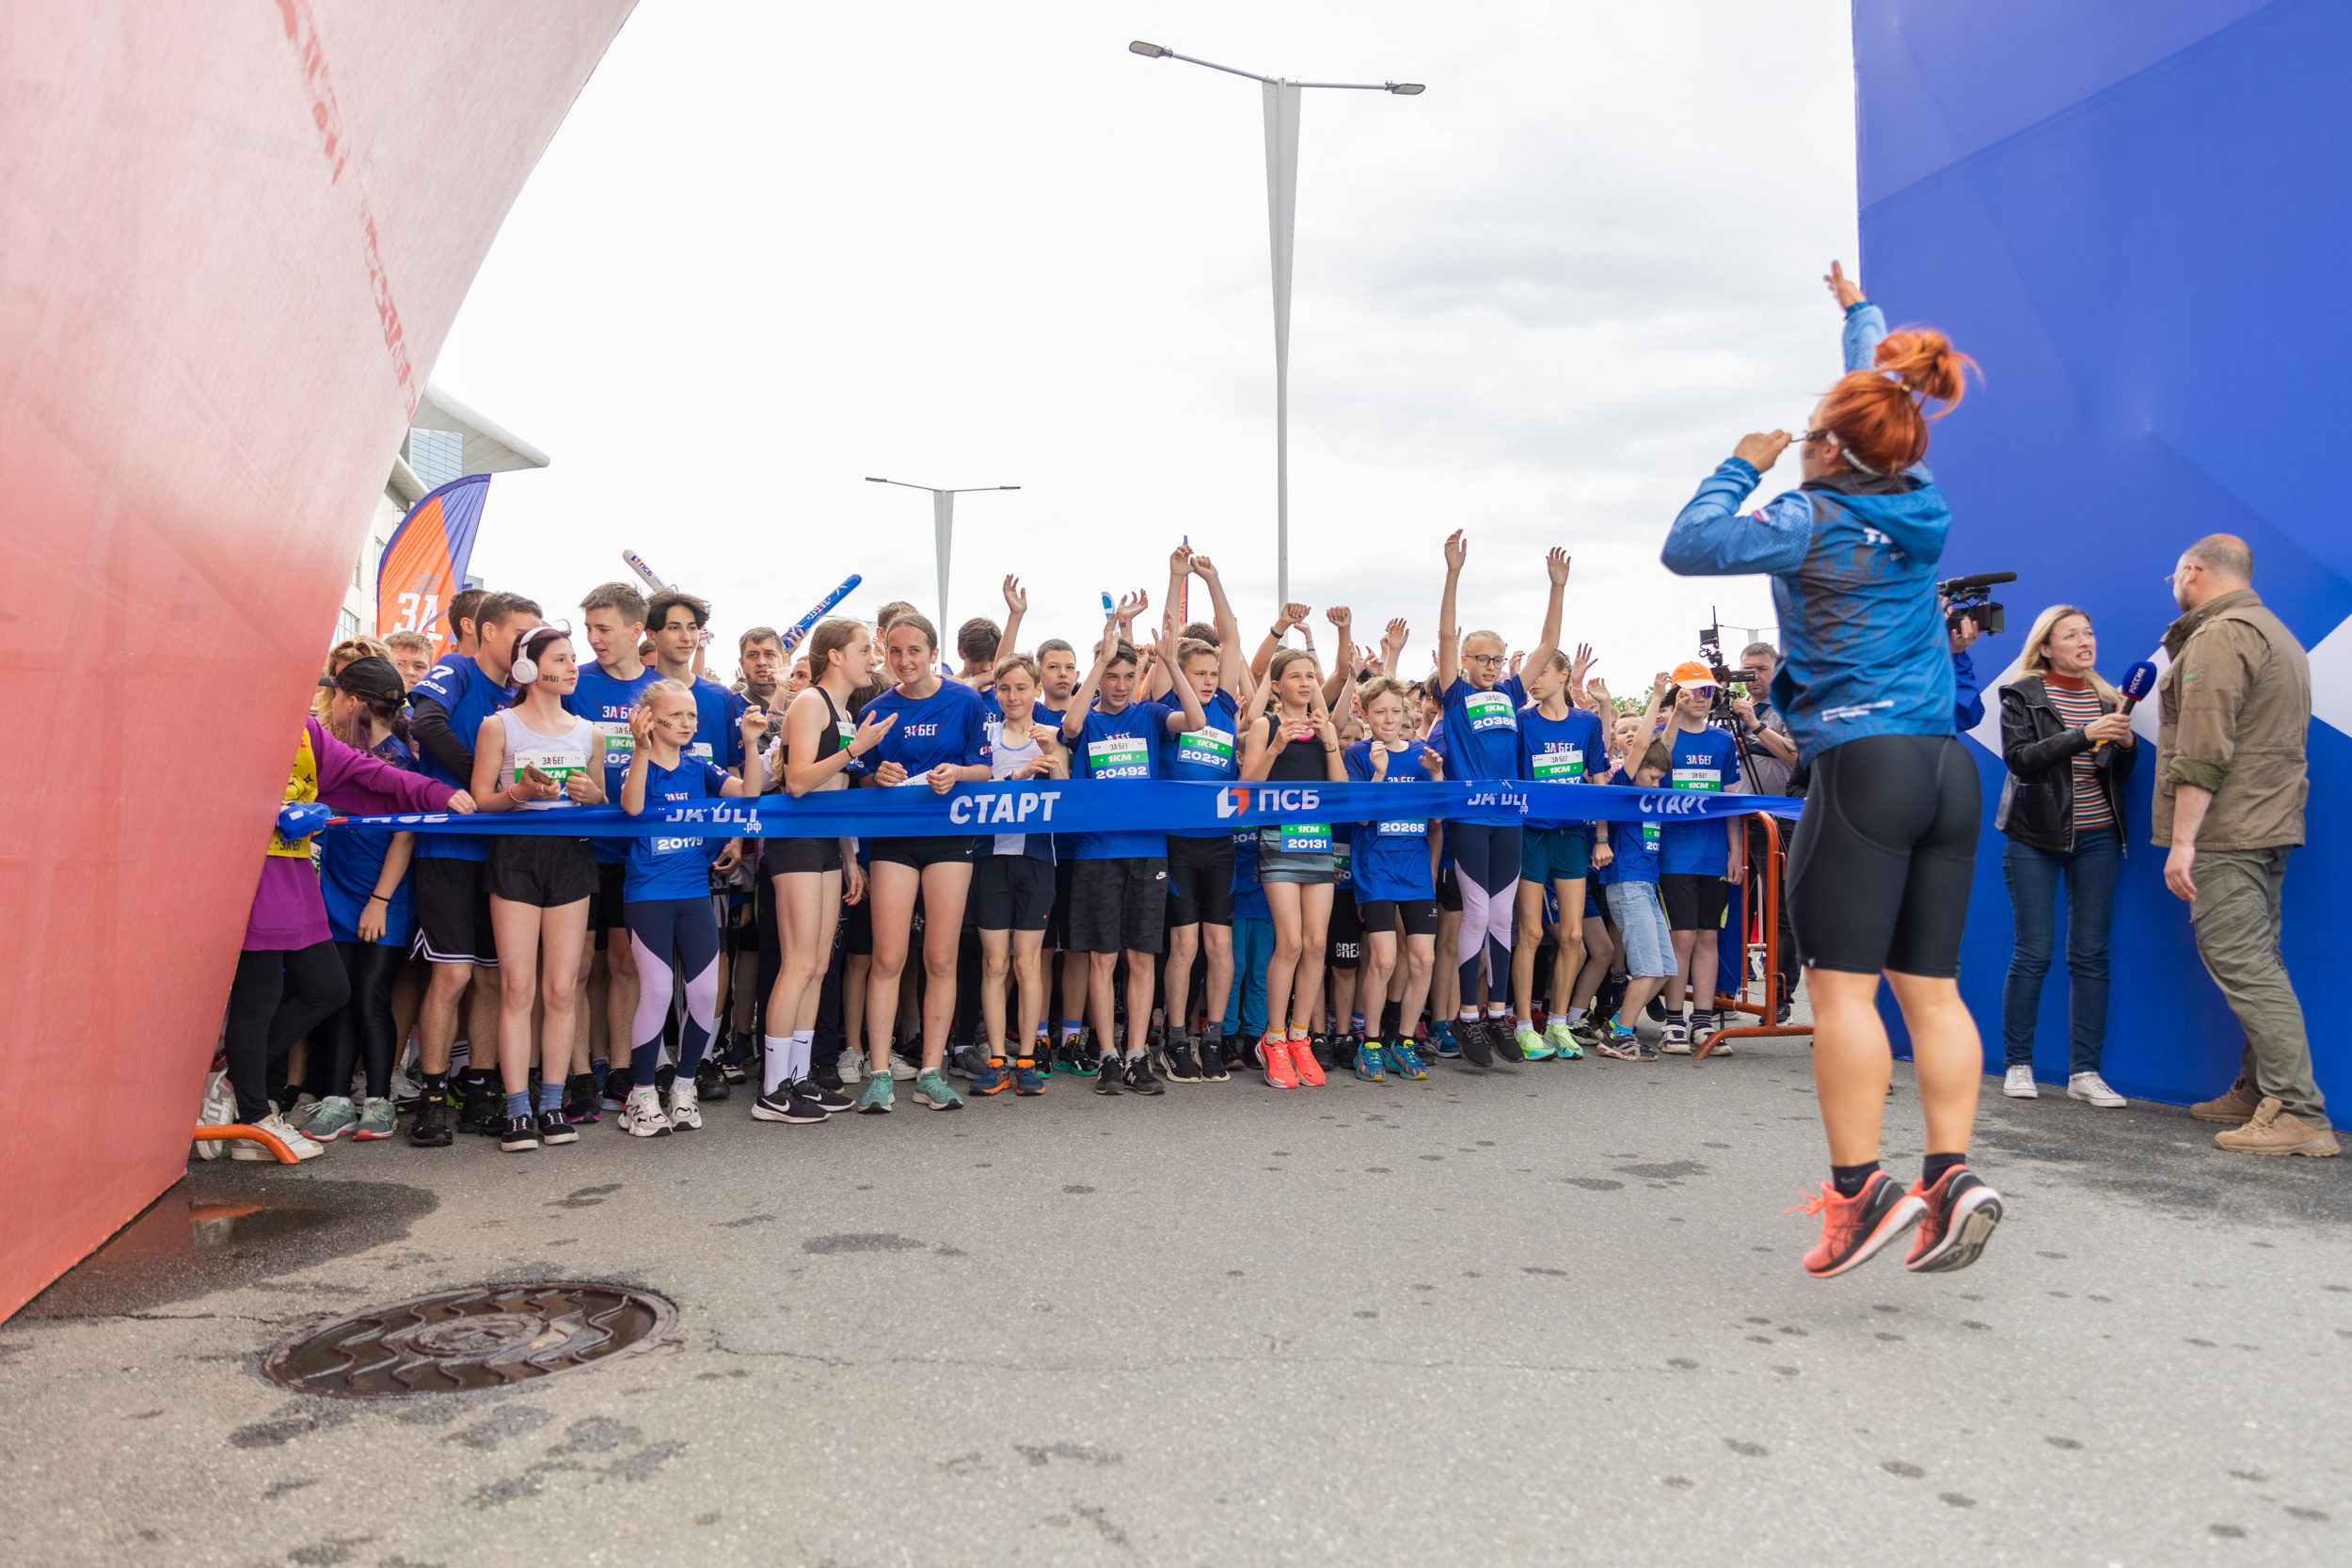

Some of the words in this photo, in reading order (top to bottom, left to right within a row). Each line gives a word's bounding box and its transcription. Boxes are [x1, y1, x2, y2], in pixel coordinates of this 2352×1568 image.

[431, 665, 454, 680] 7
[2128, 667, 2146, 694] РОССИЯ
[1473, 716, 1516, 730] 20386
[1181, 749, 1229, 768] 20237
[1095, 766, 1148, 779] 20492
[1259, 789, 1320, 811] ПСБ
[1638, 794, 1710, 815] СТАРТ
[949, 791, 1061, 825] СТАРТ
[1380, 823, 1425, 832] 20265
[658, 836, 704, 850] 20179
[1288, 839, 1327, 848] 20131
